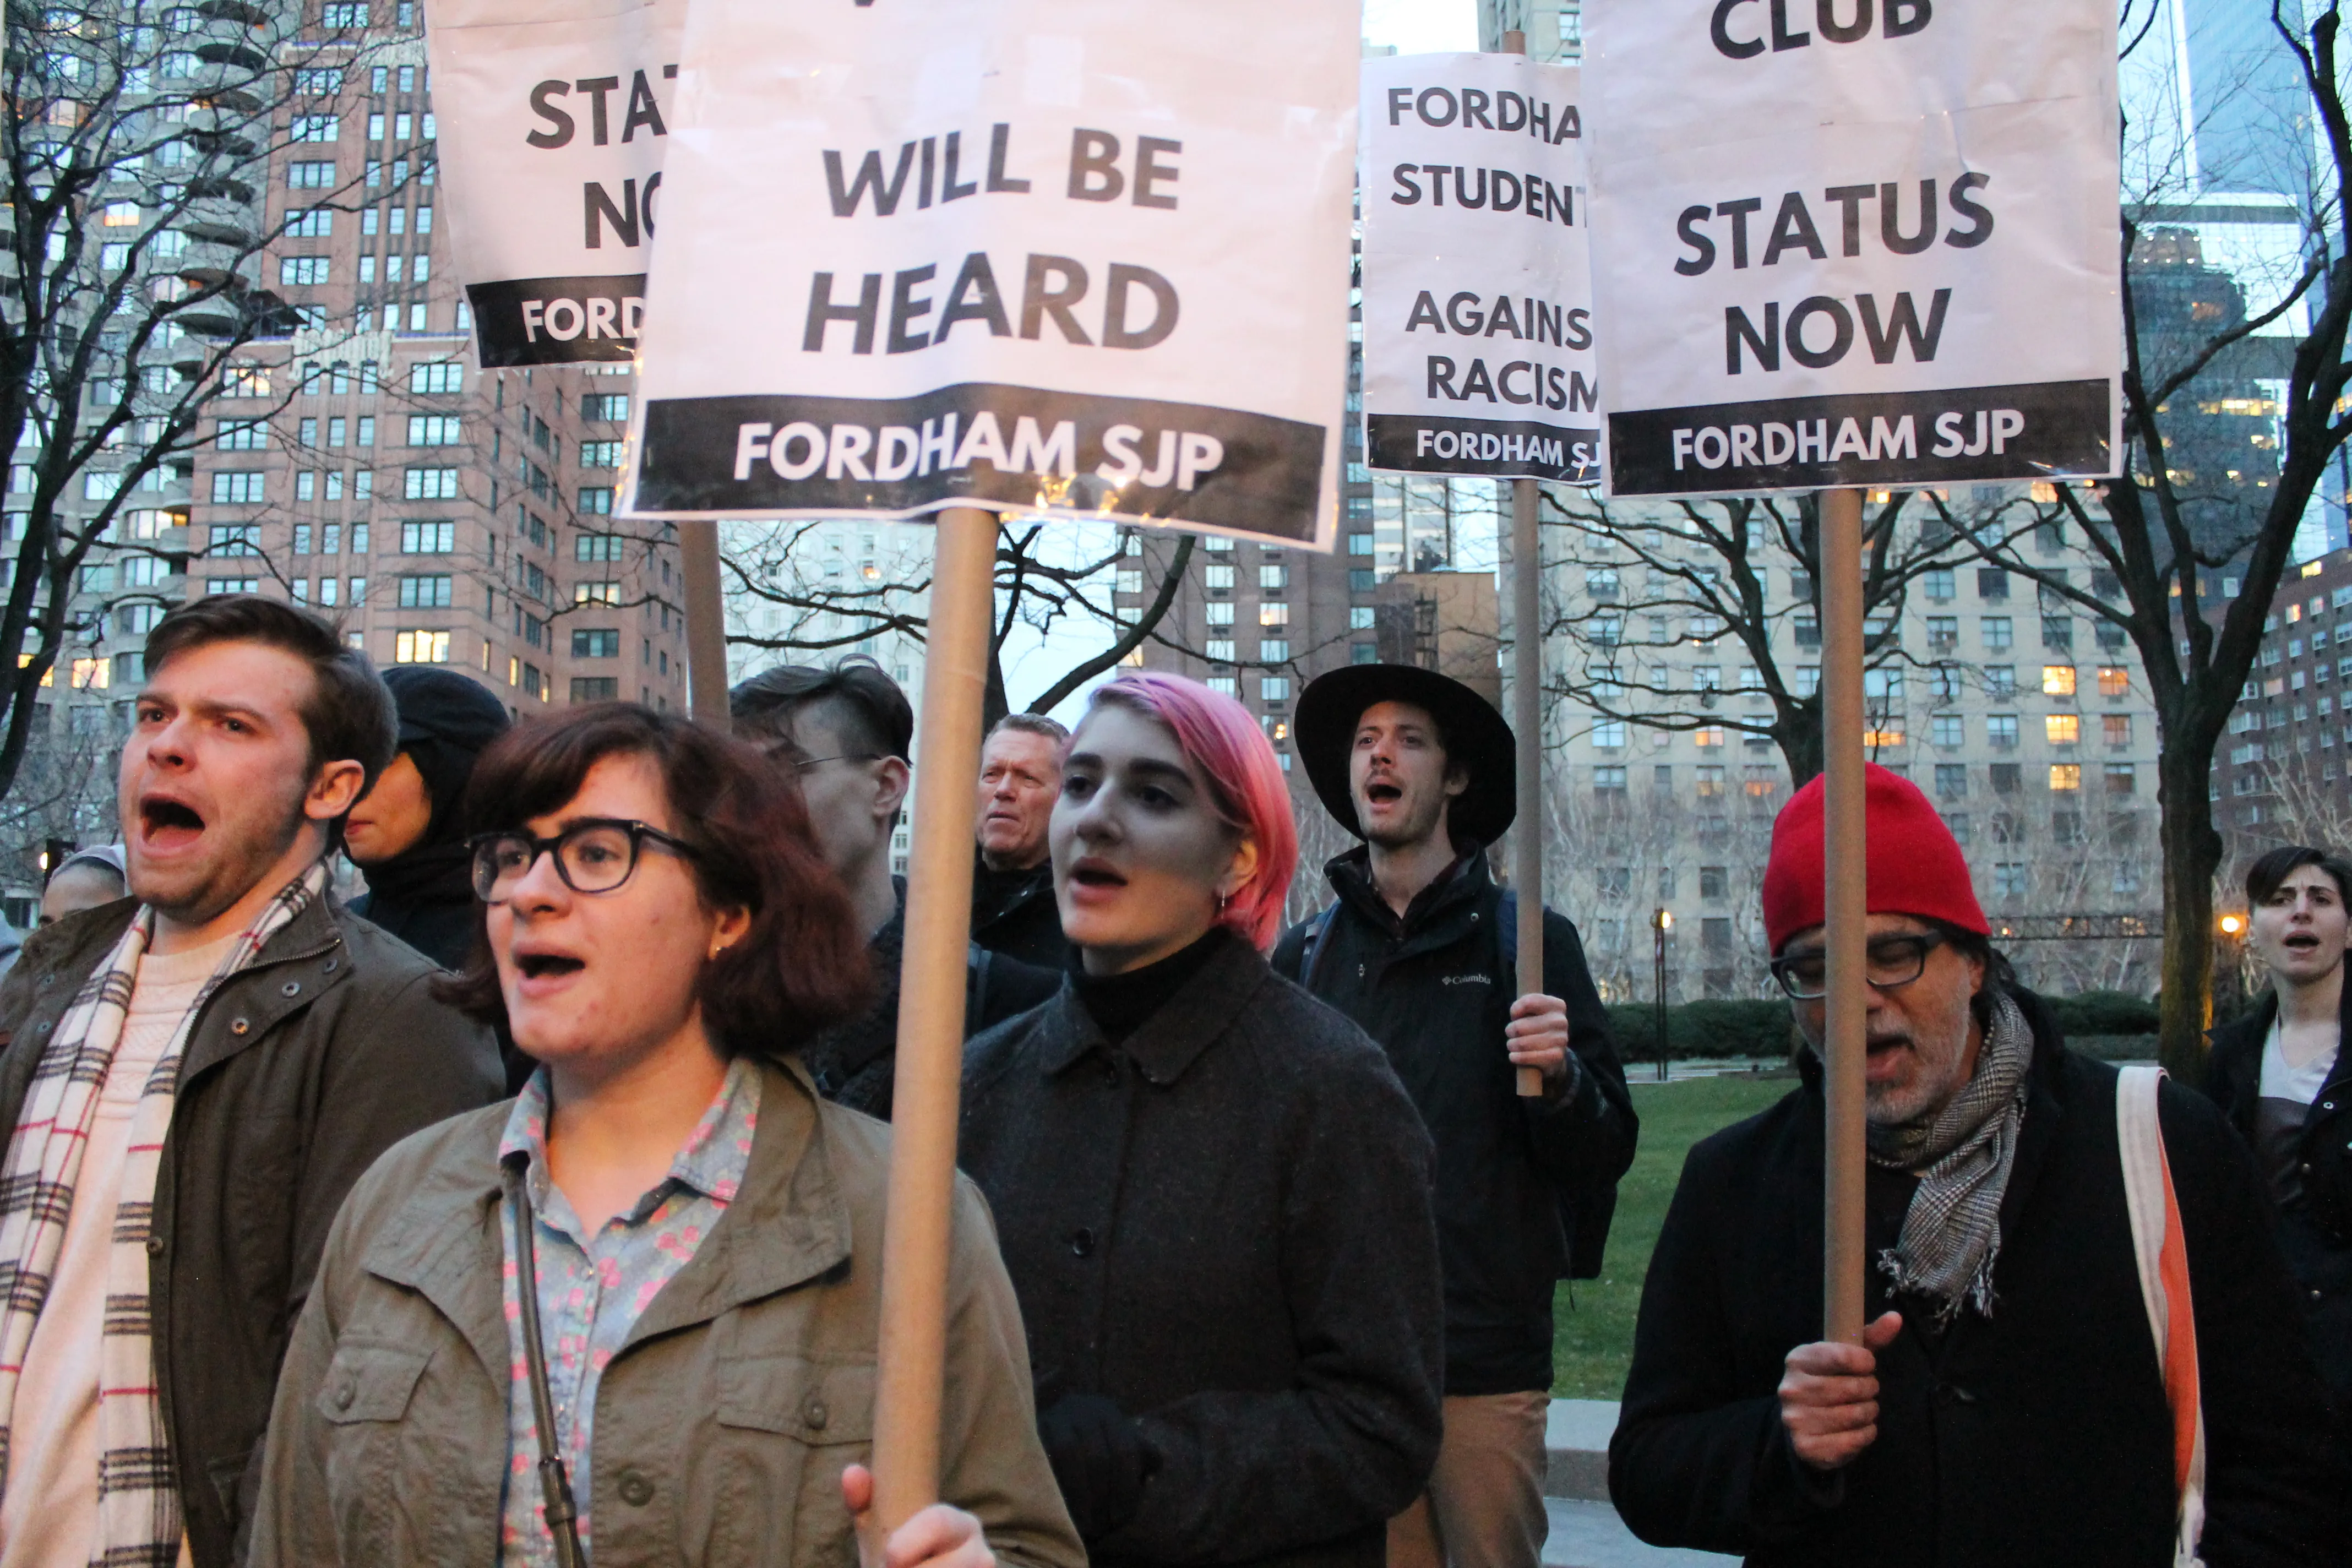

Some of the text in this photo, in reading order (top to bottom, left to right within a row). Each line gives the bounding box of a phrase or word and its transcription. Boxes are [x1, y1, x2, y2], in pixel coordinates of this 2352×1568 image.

[526, 64, 678, 149] STA
[1388, 87, 1581, 145] FORDHA
[821, 123, 1183, 217] WILL BE
[1674, 172, 1994, 276] STATUS
[802, 252, 1180, 355] HEARD
[1405, 290, 1592, 351] AGAINS
[1725, 288, 1952, 375] NOW
[1427, 355, 1598, 413] RACISM
[734, 412, 1224, 492] FORDHAM SJP
[1417, 430, 1564, 467] FORDHAM
[1673, 409, 2026, 471] FORDHAM SJP
[1452, 974, 1491, 984] Columbia
